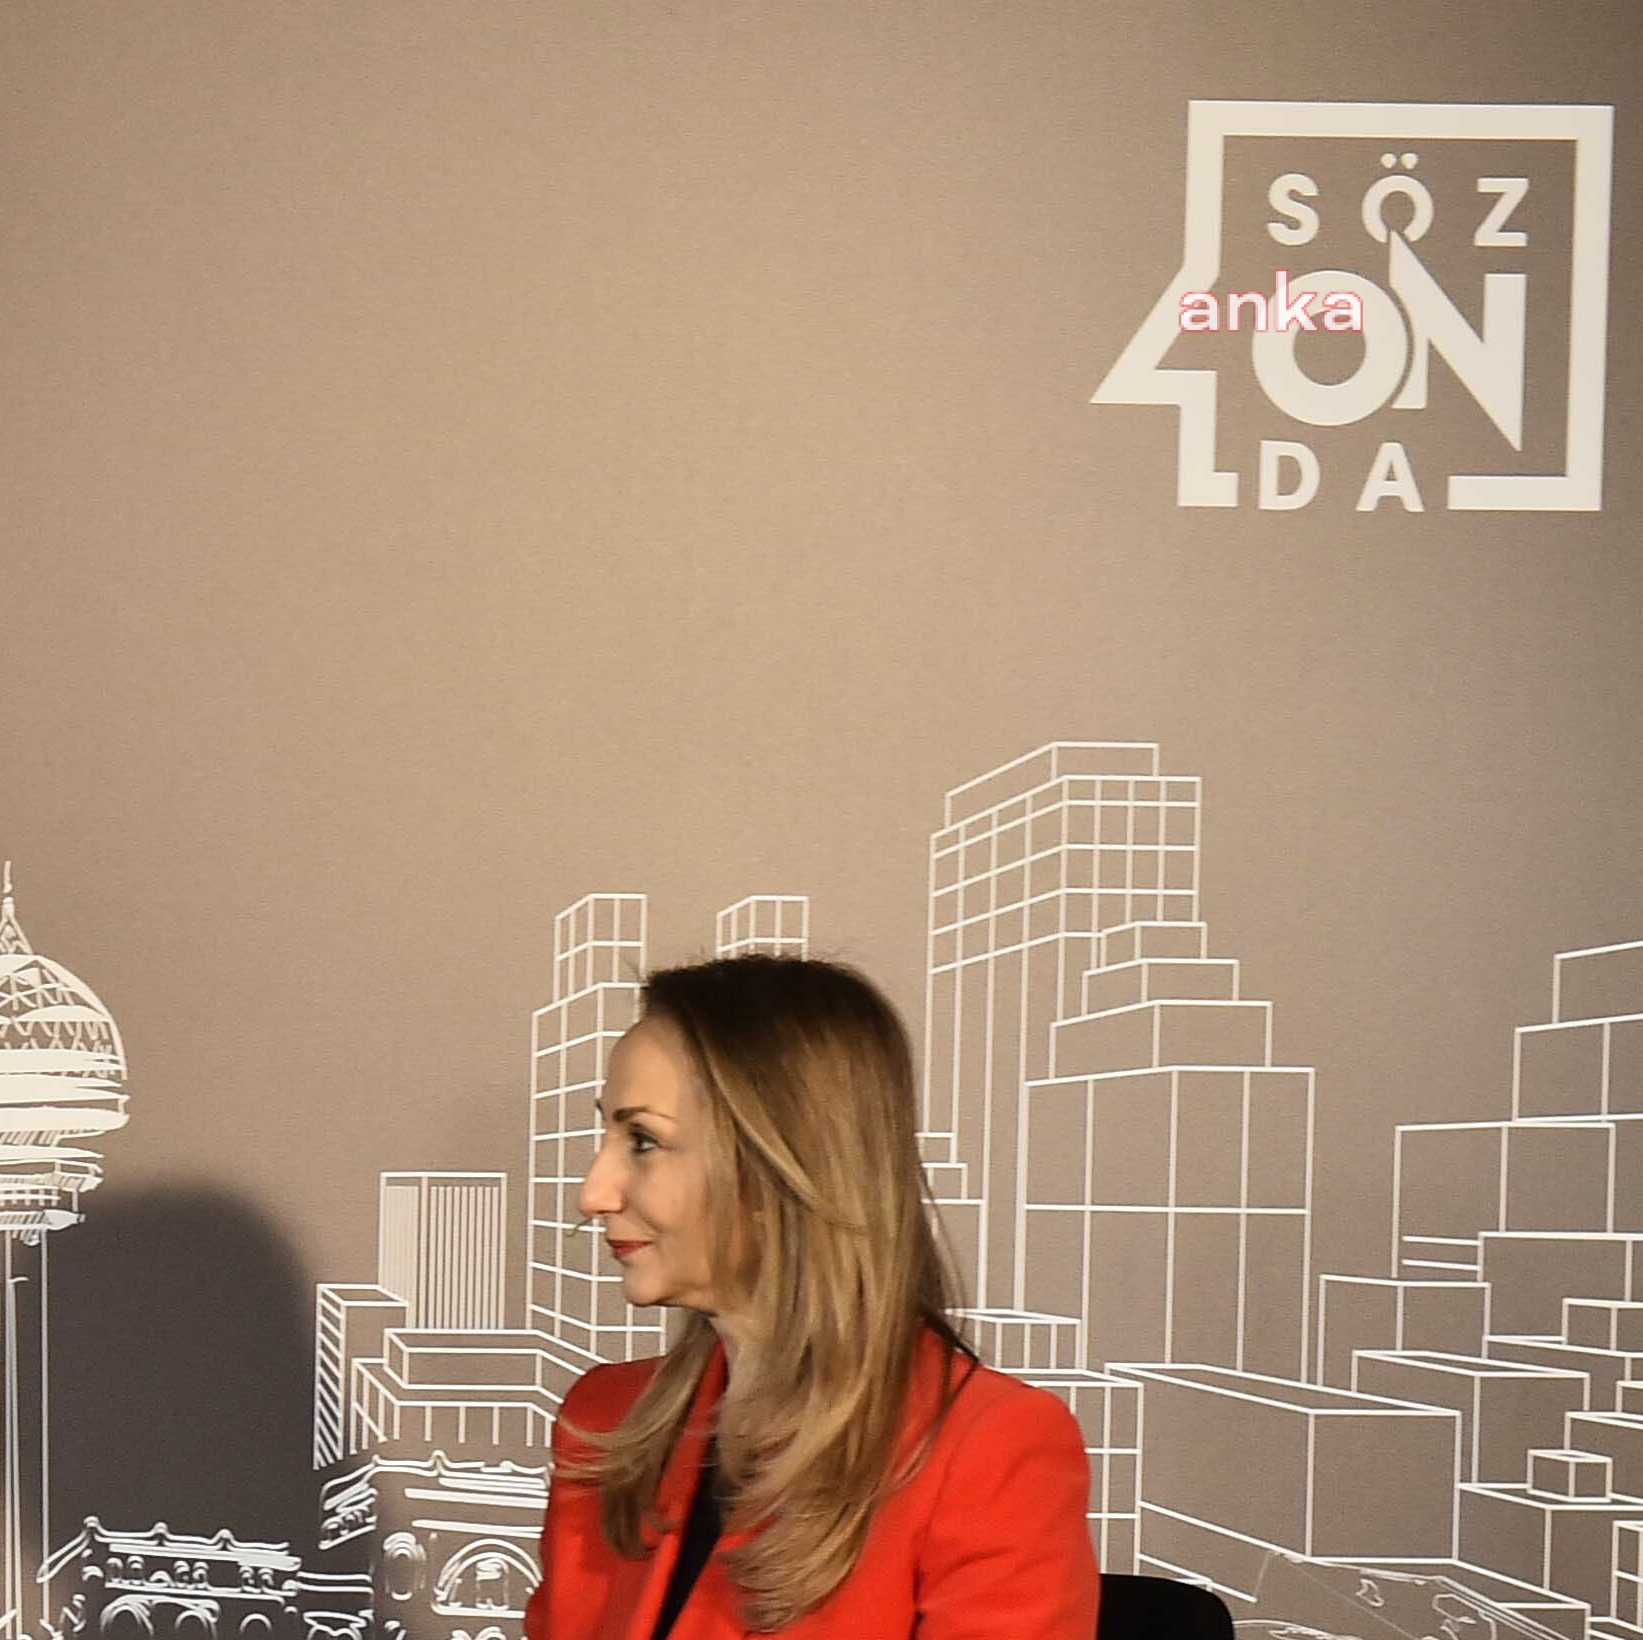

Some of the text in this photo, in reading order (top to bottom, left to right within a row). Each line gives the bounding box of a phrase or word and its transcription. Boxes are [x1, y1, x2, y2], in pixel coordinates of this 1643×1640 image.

[1266, 152, 1530, 247] SÖZ
[1251, 229, 1528, 452] ON
[1257, 439, 1426, 513] DA
